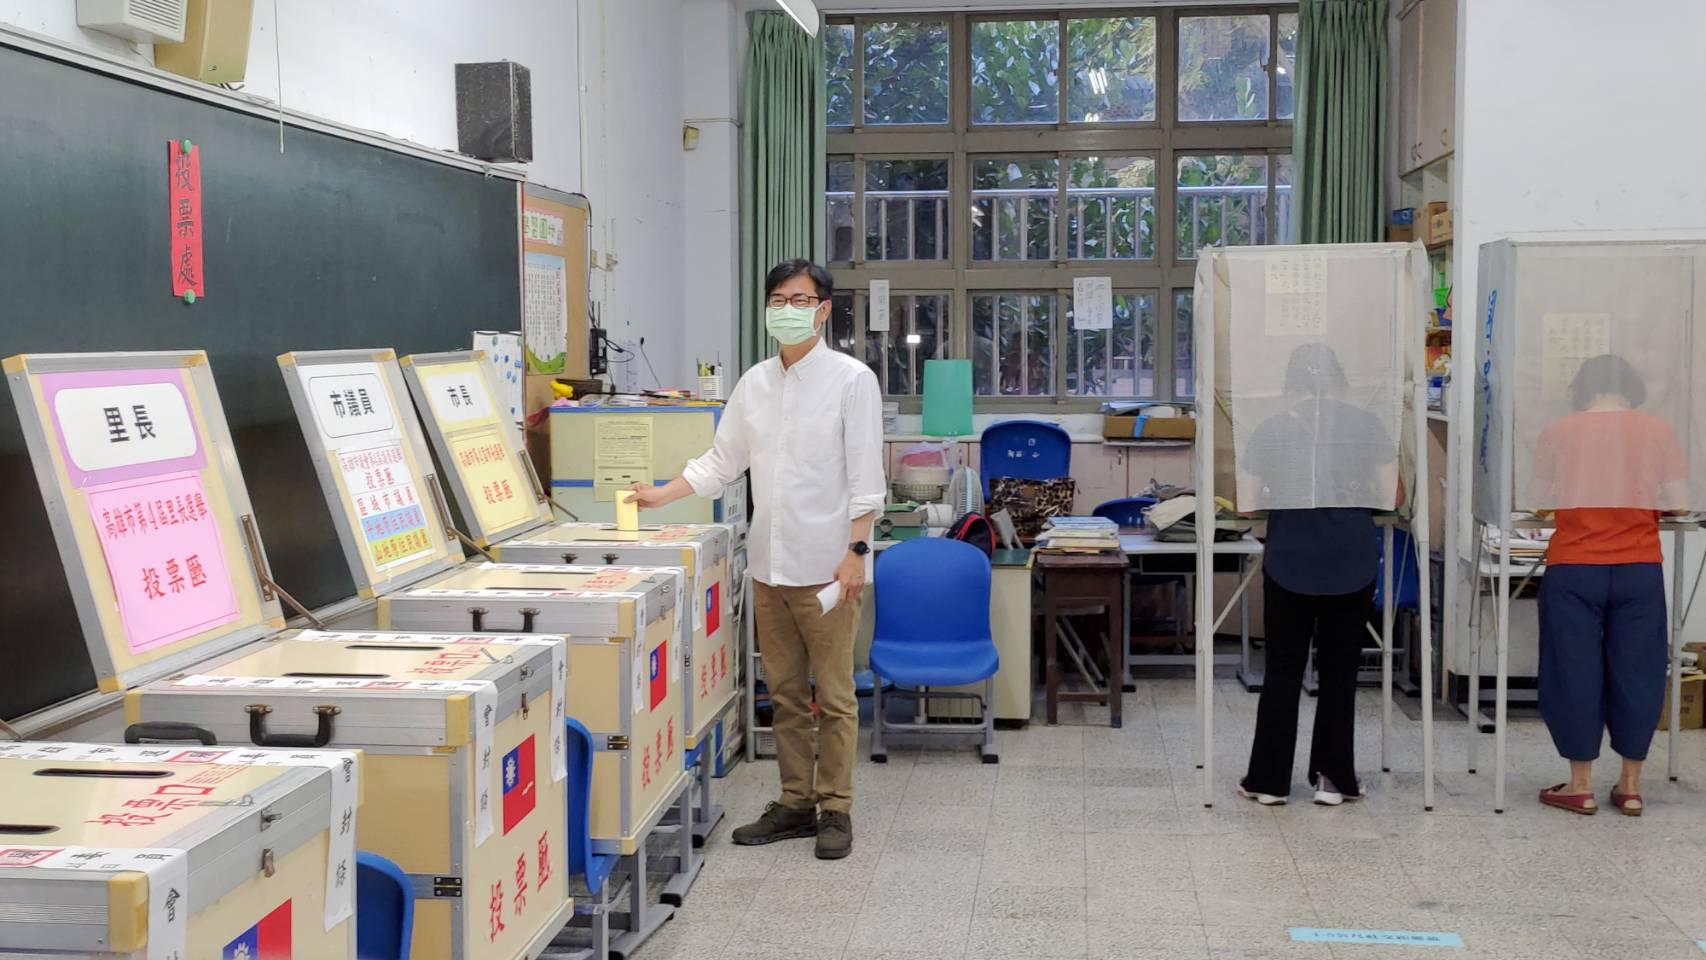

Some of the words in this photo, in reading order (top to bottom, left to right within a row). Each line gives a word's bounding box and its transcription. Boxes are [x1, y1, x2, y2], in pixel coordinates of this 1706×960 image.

[329, 388, 375, 418] 市議員
[447, 385, 473, 408] 市長
[103, 404, 156, 443] 里長
